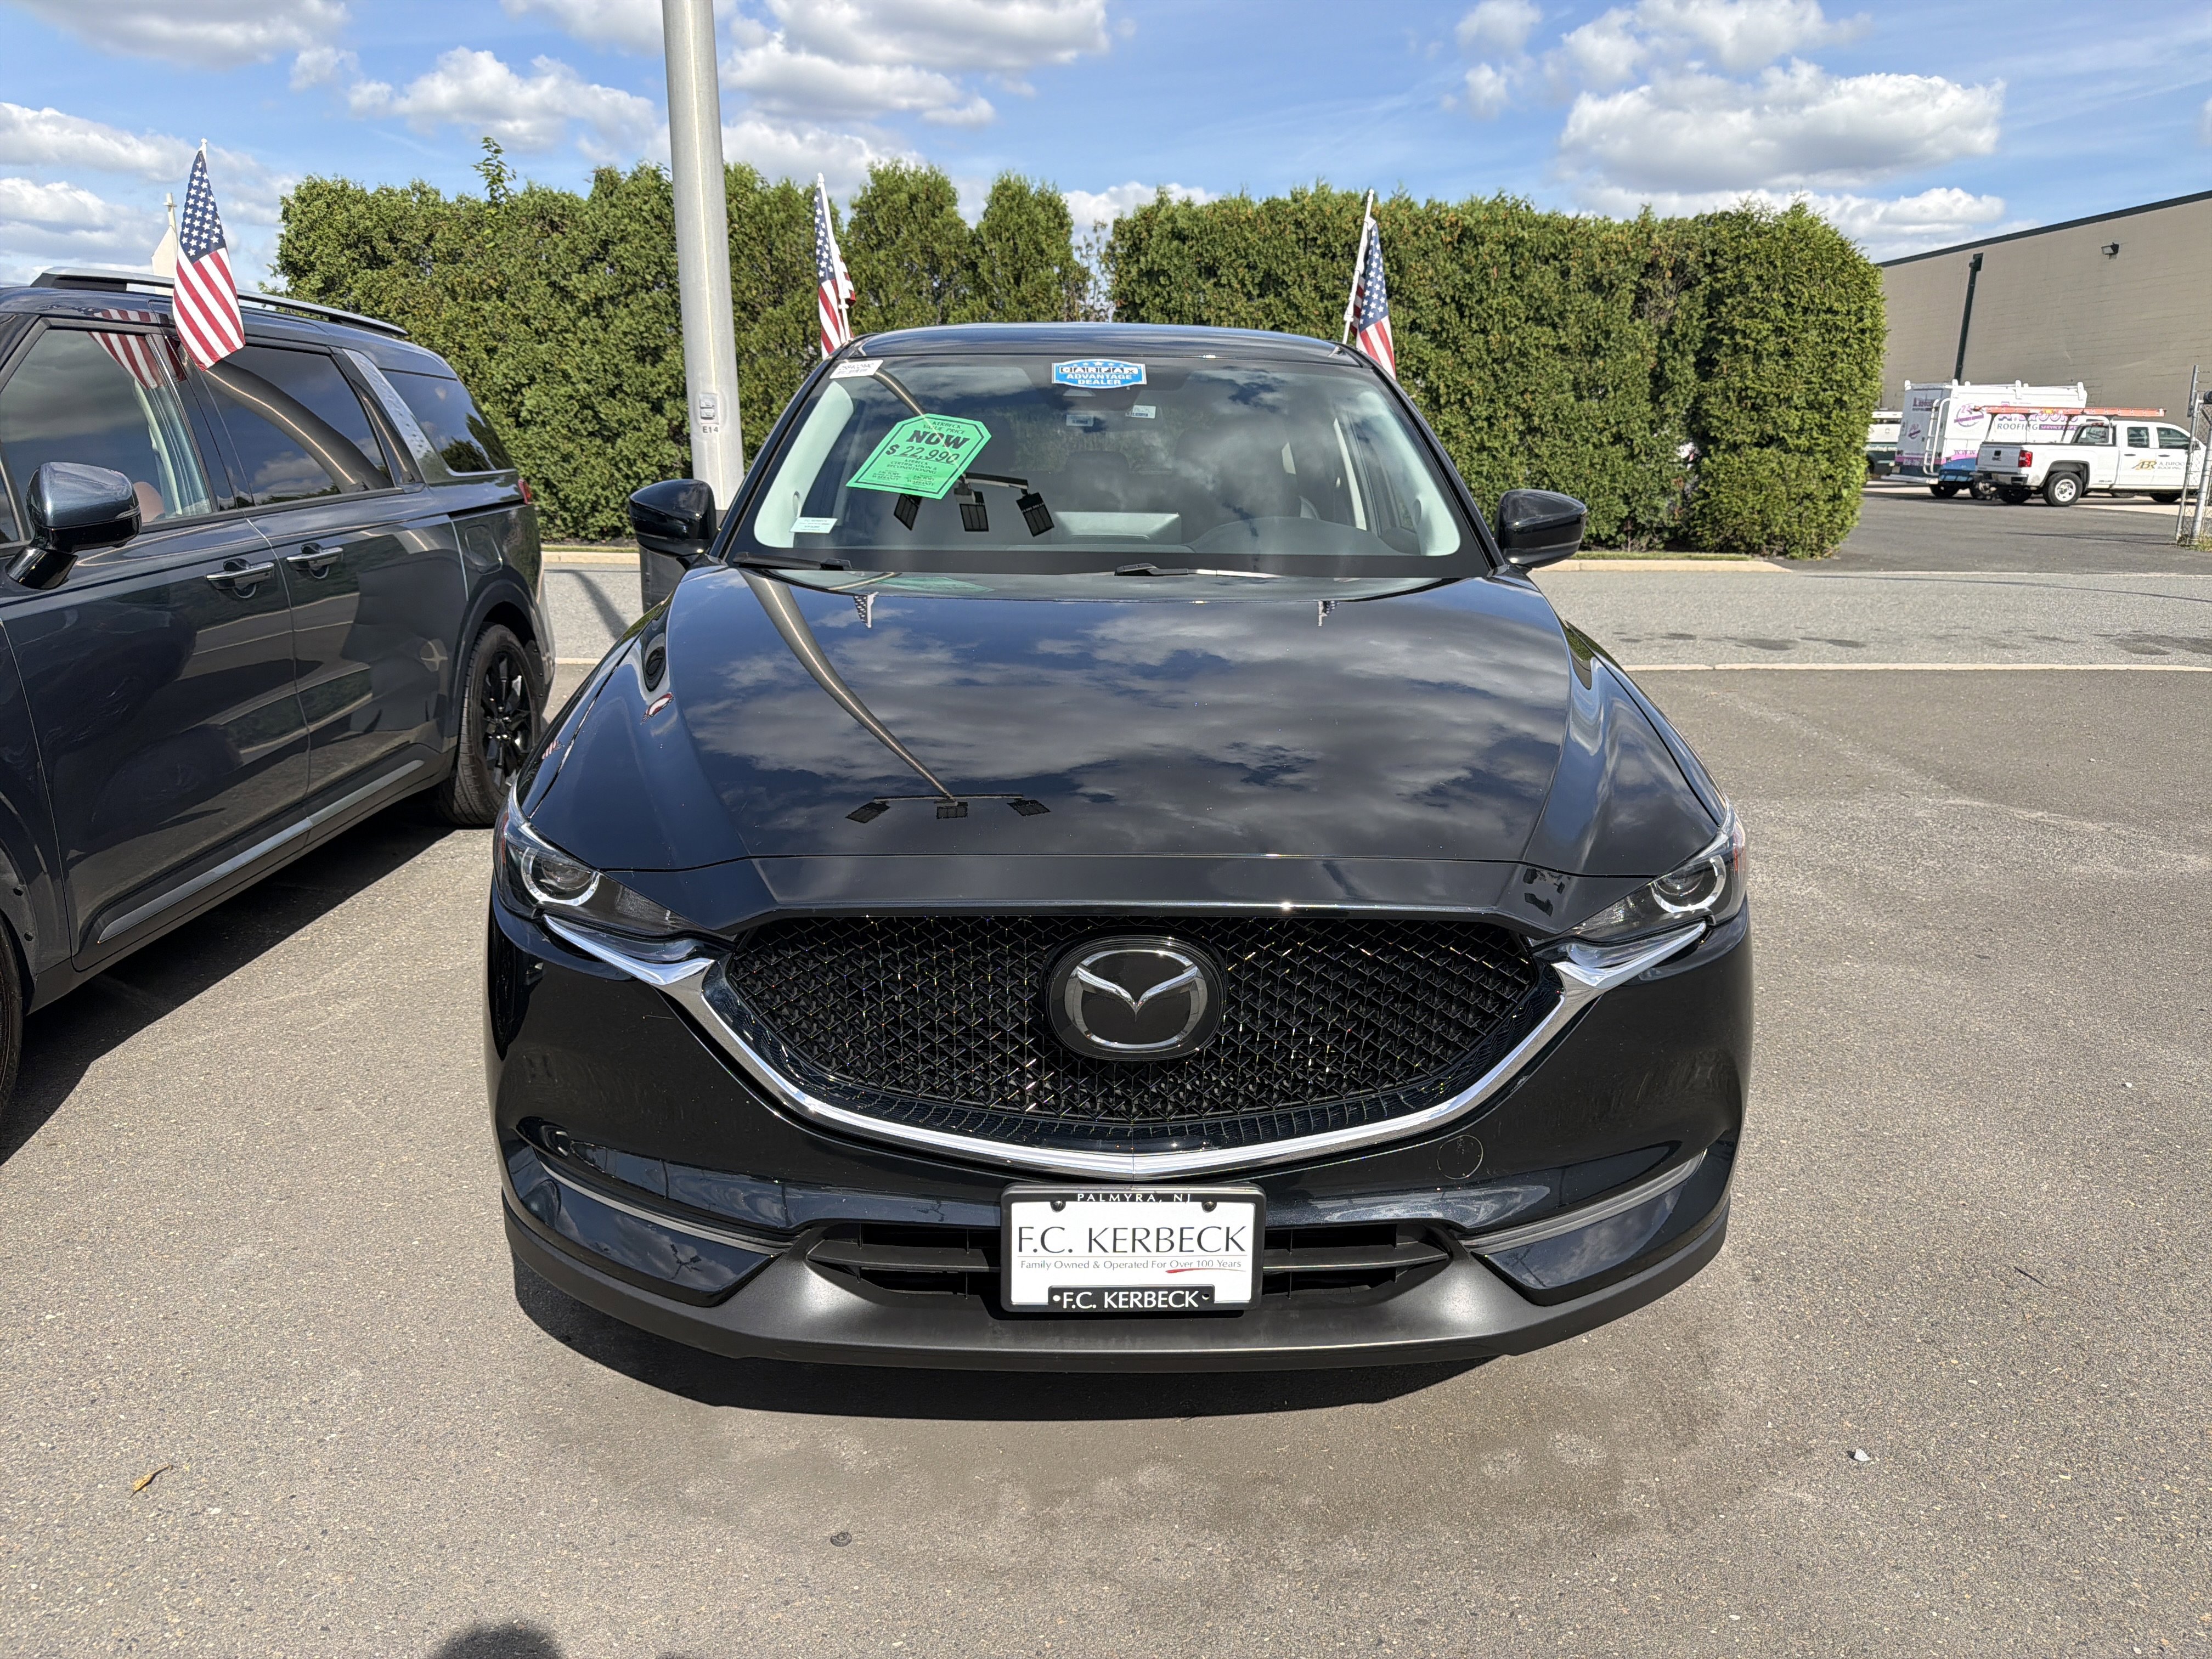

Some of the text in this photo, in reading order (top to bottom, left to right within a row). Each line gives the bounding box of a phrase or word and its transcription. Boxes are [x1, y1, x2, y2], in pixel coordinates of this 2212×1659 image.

[906, 430, 970, 449] NOW
[885, 444, 960, 464] $ 22,990
[1077, 1193, 1190, 1203] PALMYRA, NJ
[1018, 1226, 1246, 1254] F.C. KERBECK
[1021, 1261, 1052, 1271] Family
[1054, 1260, 1090, 1268] Owned
[1103, 1260, 1148, 1271] Operated
[1063, 1291, 1199, 1309] F.C. KERBECK
